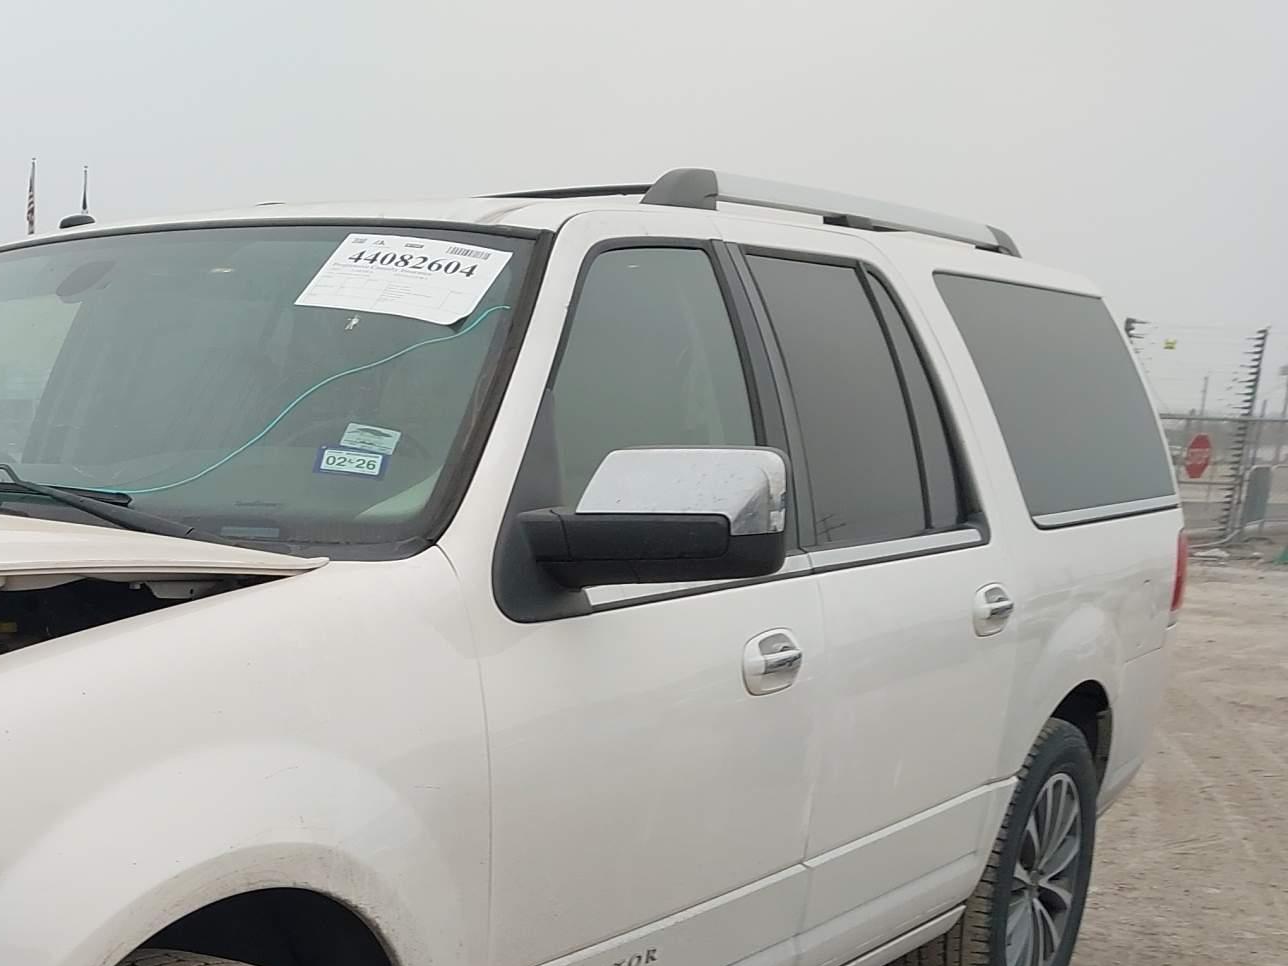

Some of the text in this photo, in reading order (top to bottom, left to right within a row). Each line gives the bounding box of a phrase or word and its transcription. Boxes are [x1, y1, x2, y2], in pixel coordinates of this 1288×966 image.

[348, 249, 477, 278] 44082604
[325, 455, 376, 471] 02 26
